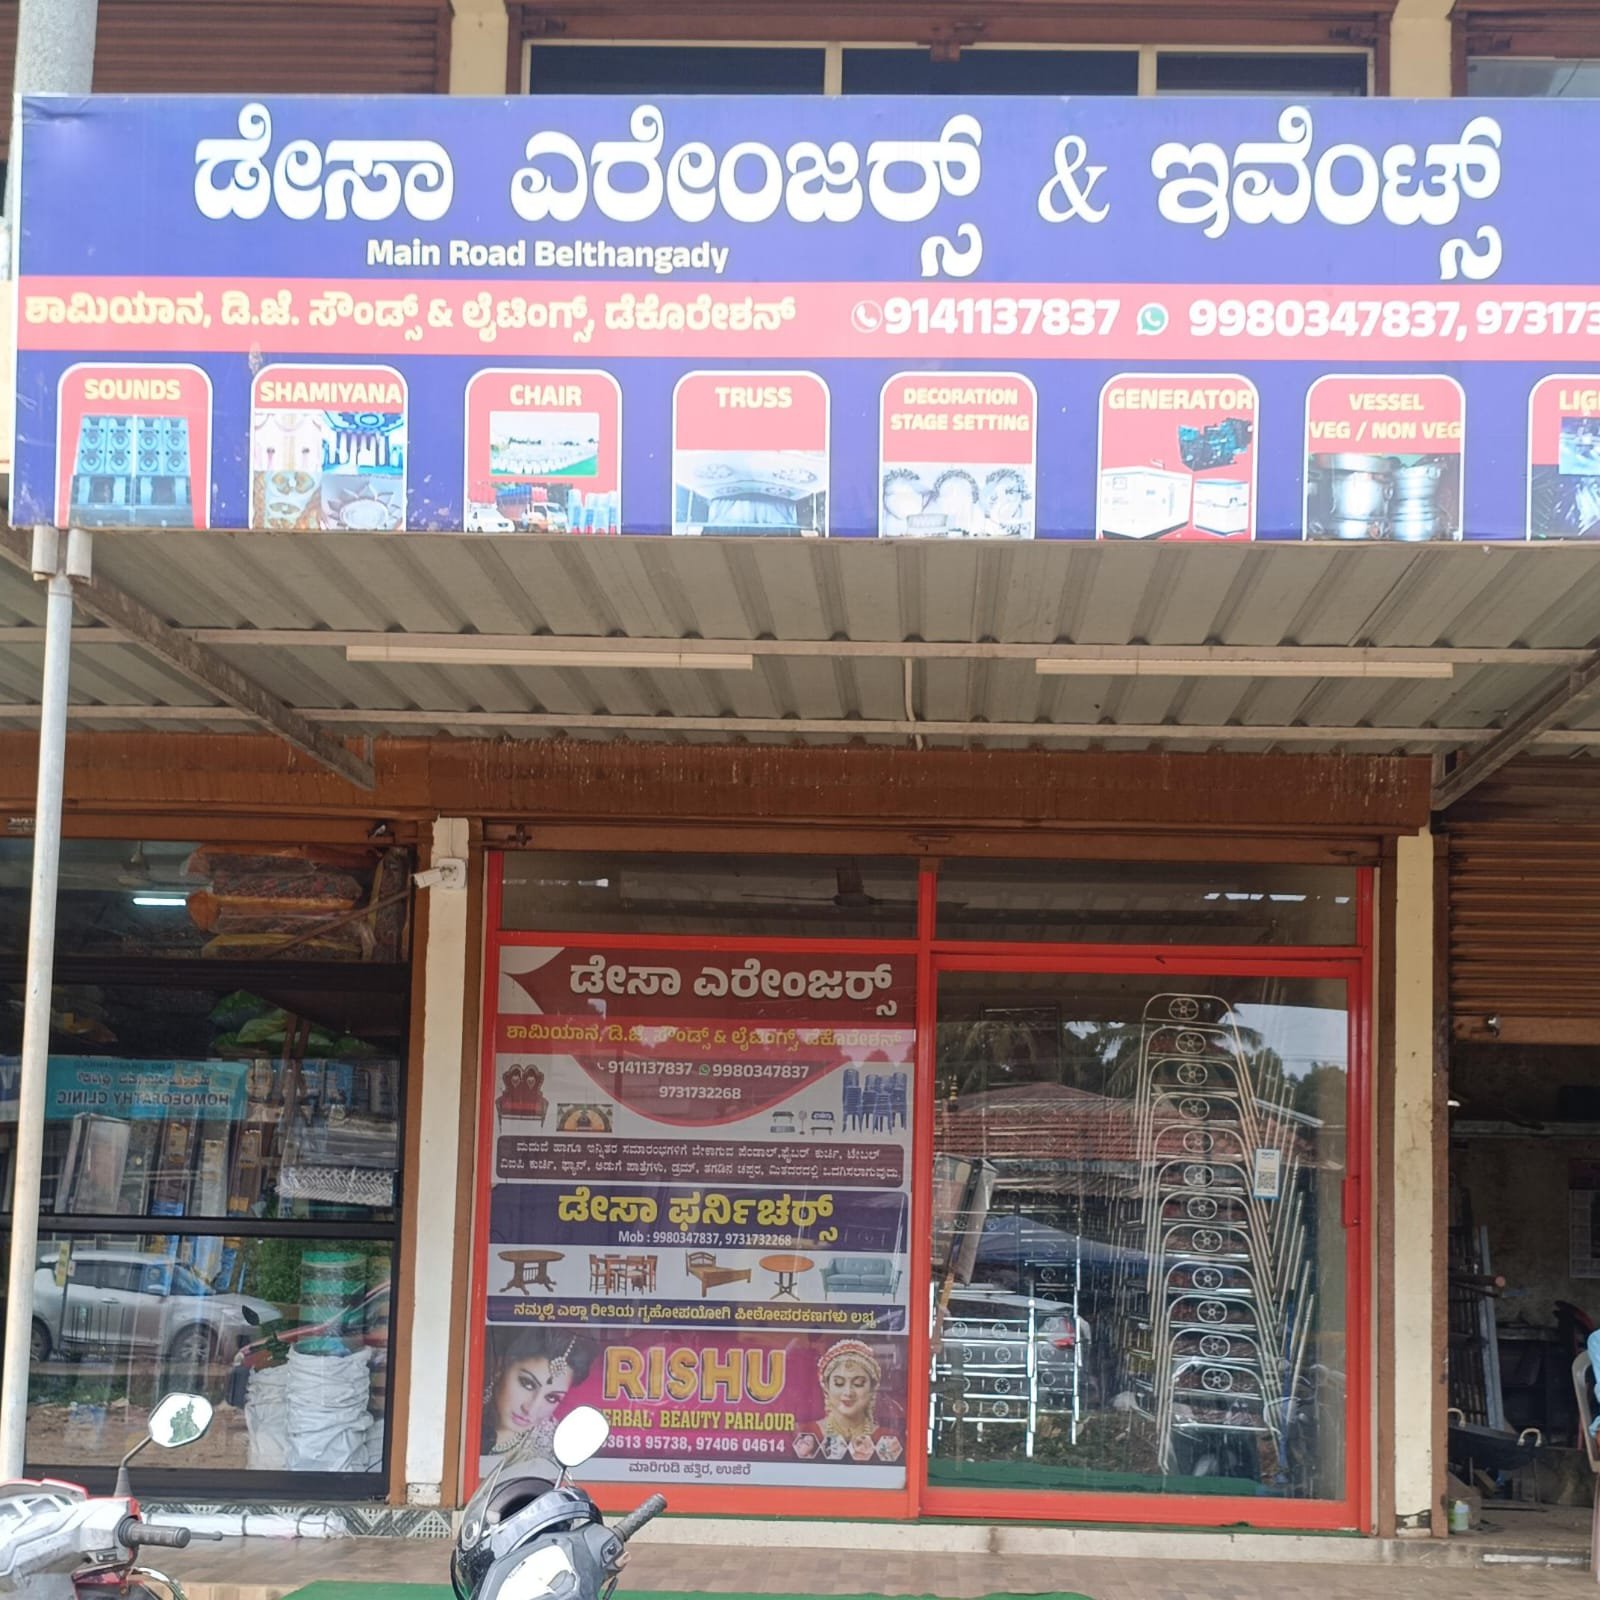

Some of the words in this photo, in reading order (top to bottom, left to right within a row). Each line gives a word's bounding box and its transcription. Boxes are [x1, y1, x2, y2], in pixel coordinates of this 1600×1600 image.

[193, 104, 454, 222] ಡೇಸಾ
[1037, 134, 1110, 224] &
[1150, 104, 1503, 281] ಇವೆಂಟ್ಸ್
[366, 238, 441, 267] Main
[449, 239, 526, 268] Road
[534, 240, 730, 274] Belthangady
[25, 291, 212, 328] ಶಾಮಿಯಾನ,
[220, 290, 300, 326] ಡಿ.ಜೆ.
[308, 291, 424, 341] ಸೌಂಡ್ಸ್
[427, 298, 454, 329] &
[884, 298, 1120, 334] 9141137837
[1188, 300, 1468, 342] 9980347837,
[84, 378, 181, 401] SOUNDS
[259, 381, 403, 404] SHAMIYANA
[509, 385, 582, 406] CHAIR
[714, 386, 792, 409] TRUSS
[903, 388, 1018, 405] DECORATION
[1107, 388, 1254, 410] GENERATOR
[1559, 389, 1600, 411] LIG
[1348, 394, 1424, 412] VESSEL
[890, 414, 950, 431] STAGE
[953, 415, 1030, 432] SETTING
[1309, 421, 1352, 440] VEG
[1372, 422, 1421, 440] NON
[1423, 422, 1461, 440] VEG
[570, 954, 681, 997] ಡೇಸಾ
[506, 1023, 603, 1043] ಶಾಮಿಯಾನ,
[608, 1024, 649, 1042] ಡಿ.ಜೆ.
[654, 1026, 711, 1051] ಸೌಂಡ್ಸ್
[713, 1030, 727, 1044] &
[607, 1060, 693, 1076] 9141137837
[712, 1063, 810, 1079] 9980347837
[659, 1085, 742, 1100] 9731732268
[558, 1186, 658, 1222] ಡೇಸಾ
[618, 1231, 643, 1243] Mob
[652, 1231, 722, 1246] 9980347837,
[725, 1233, 792, 1246] 9731732268
[514, 1303, 556, 1322] ನಮ್ಮಲ್ಲಿ
[558, 1304, 588, 1321] ಎಲ್ಲಾ
[591, 1304, 635, 1318] ರೀತಿಯ
[638, 1304, 731, 1323] ಗೃಹೋಪಯೋಗಿ
[851, 1311, 881, 1328] ಲಭ್ಯ.
[603, 1346, 787, 1402] RISHU
[602, 1409, 652, 1427] ERBAL
[660, 1410, 721, 1430] BEAUTY
[724, 1412, 795, 1432] PARLOUR
[603, 1435, 641, 1449] 3613
[645, 1436, 692, 1452] 95738,
[695, 1438, 738, 1451] 97406
[742, 1439, 785, 1453] 04614
[628, 1462, 680, 1473] ಮಾರಿಗುಡಿ
[683, 1463, 713, 1478] ಹತ್ತಿರ,
[716, 1464, 752, 1475] ಉಜಿರೆ
